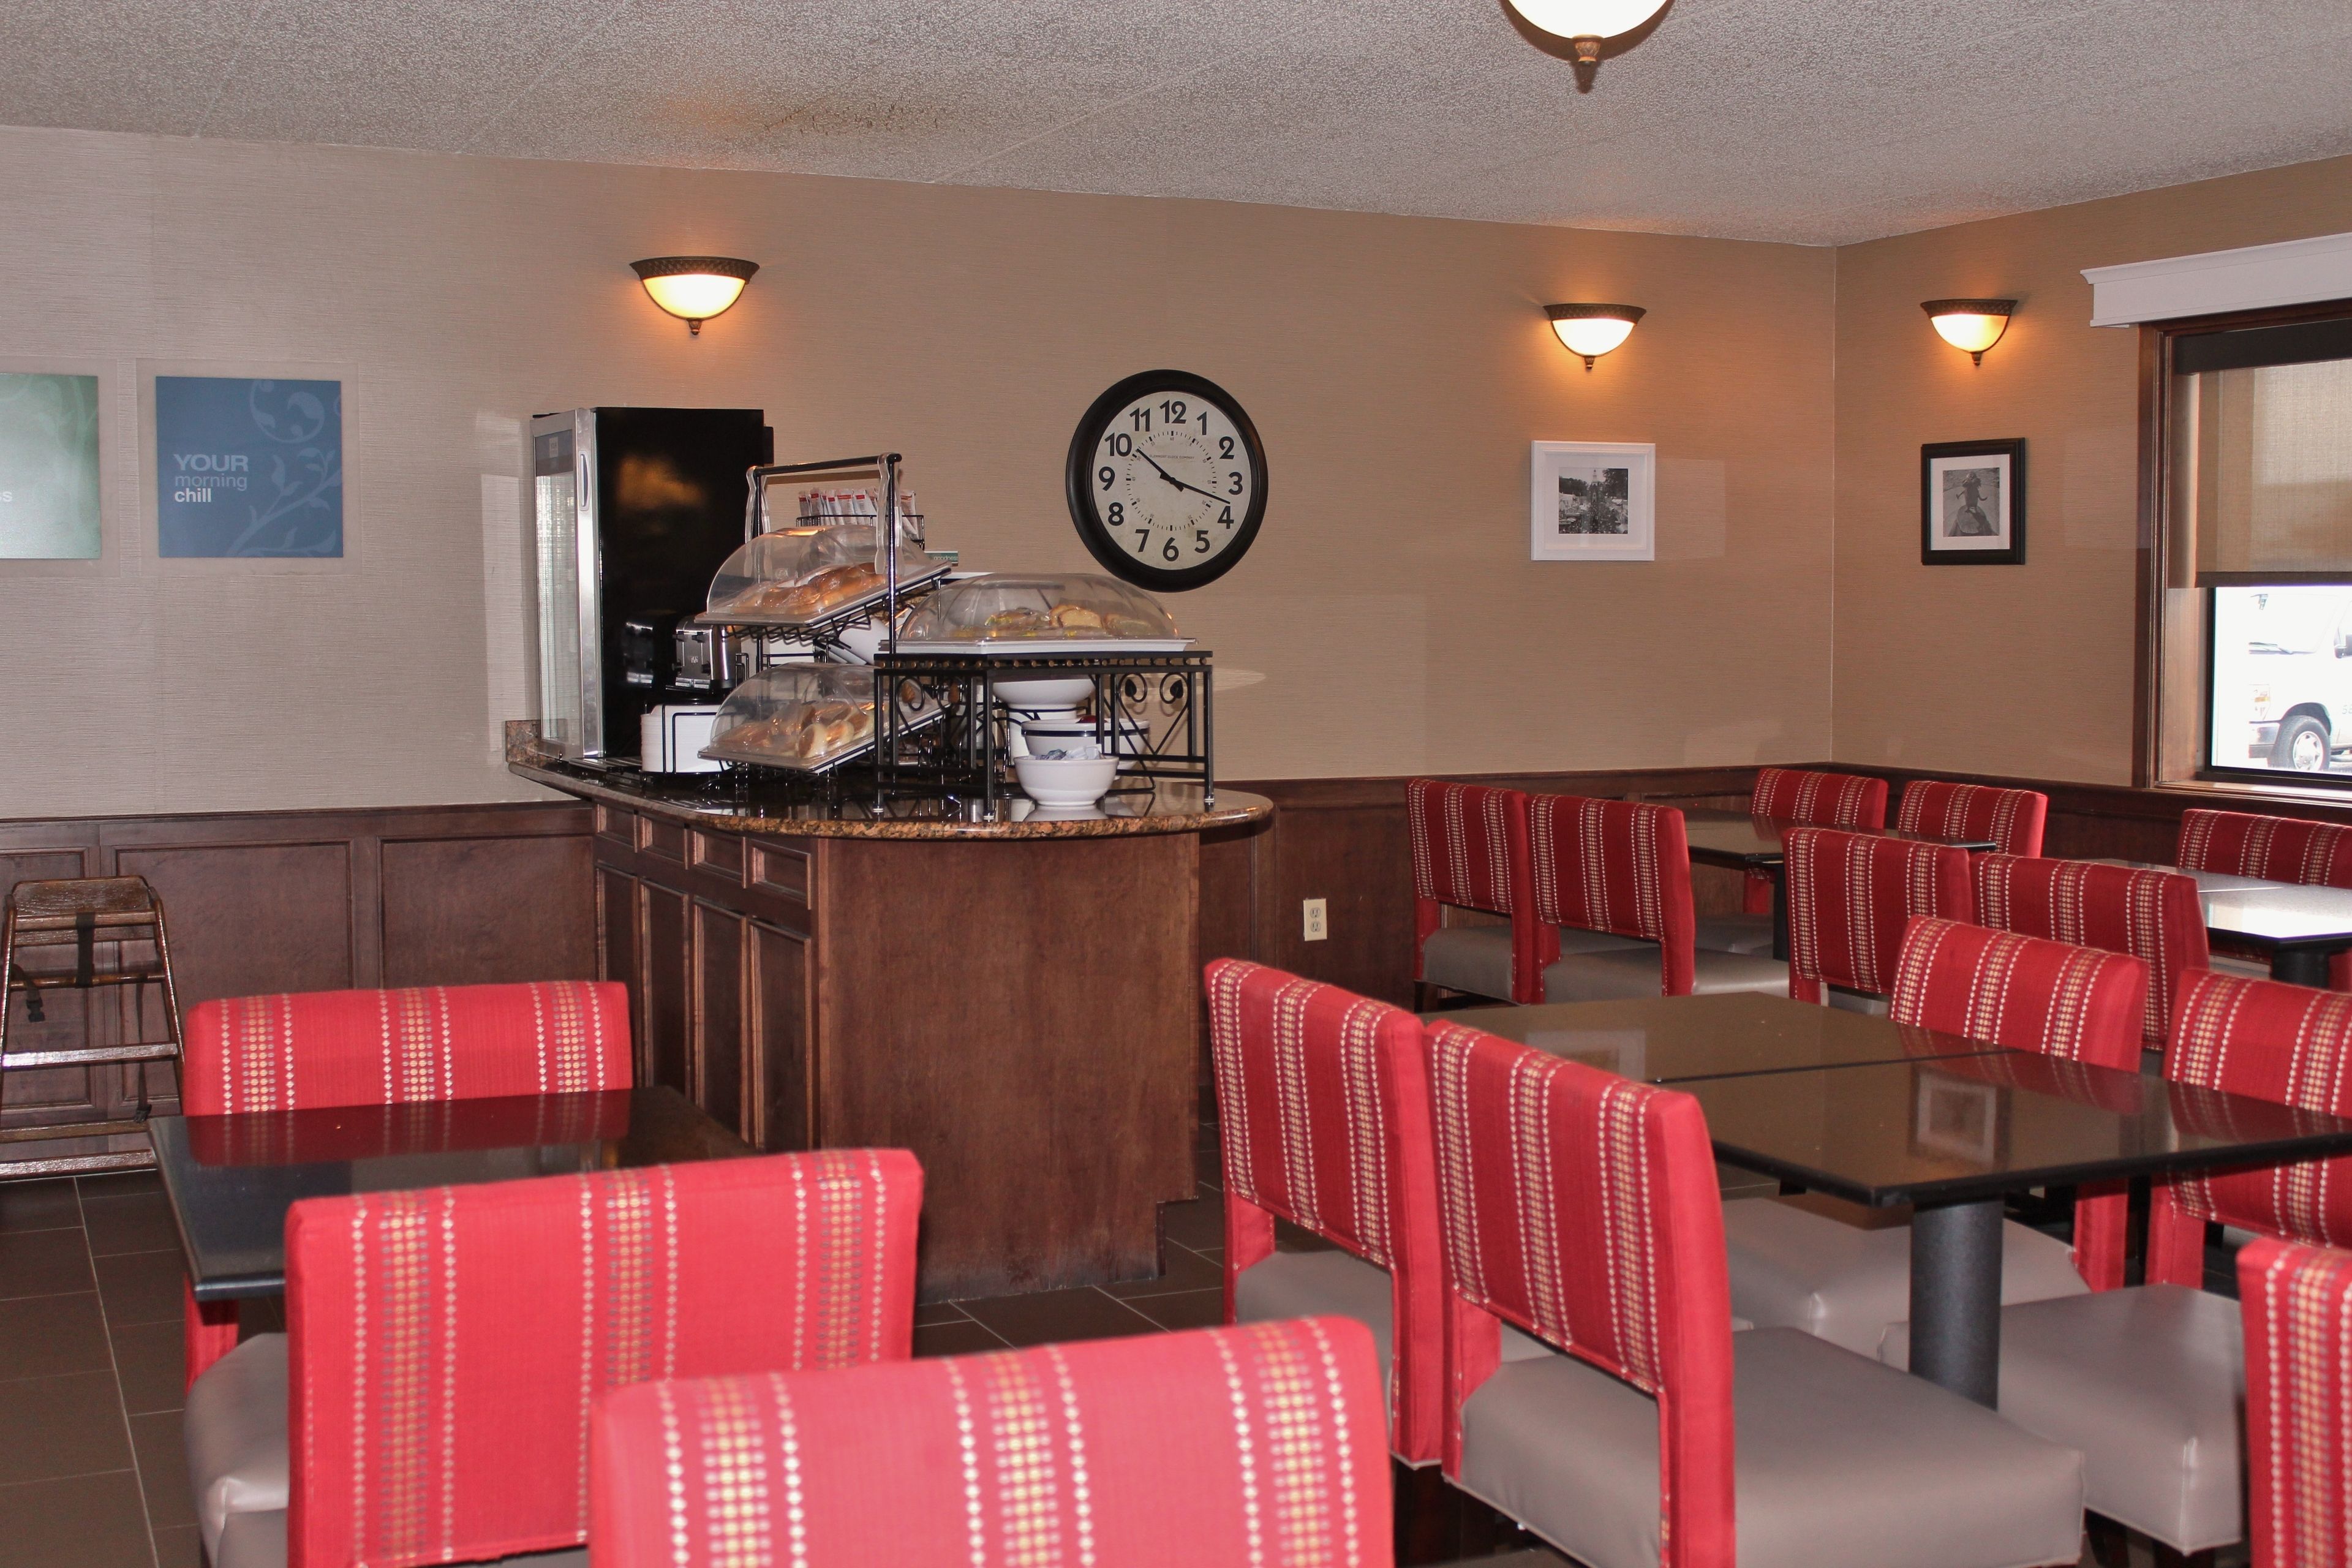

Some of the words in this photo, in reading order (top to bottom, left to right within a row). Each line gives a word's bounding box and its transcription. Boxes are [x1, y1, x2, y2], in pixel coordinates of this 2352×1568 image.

[1129, 407, 1150, 432] 11
[1159, 399, 1187, 424] 12
[1196, 411, 1207, 435] 1
[1104, 432, 1133, 457] 10
[1219, 435, 1235, 460] 2
[173, 454, 249, 472] YOUR
[175, 473, 247, 491] morning
[1098, 466, 1115, 491] 9
[1228, 471, 1243, 496] 3
[175, 488, 212, 502] chill
[1107, 502, 1125, 527] 8
[1217, 505, 1235, 530] 4
[1135, 529, 1150, 553] 7
[1163, 537, 1179, 562] 6
[1194, 529, 1210, 554] 5
